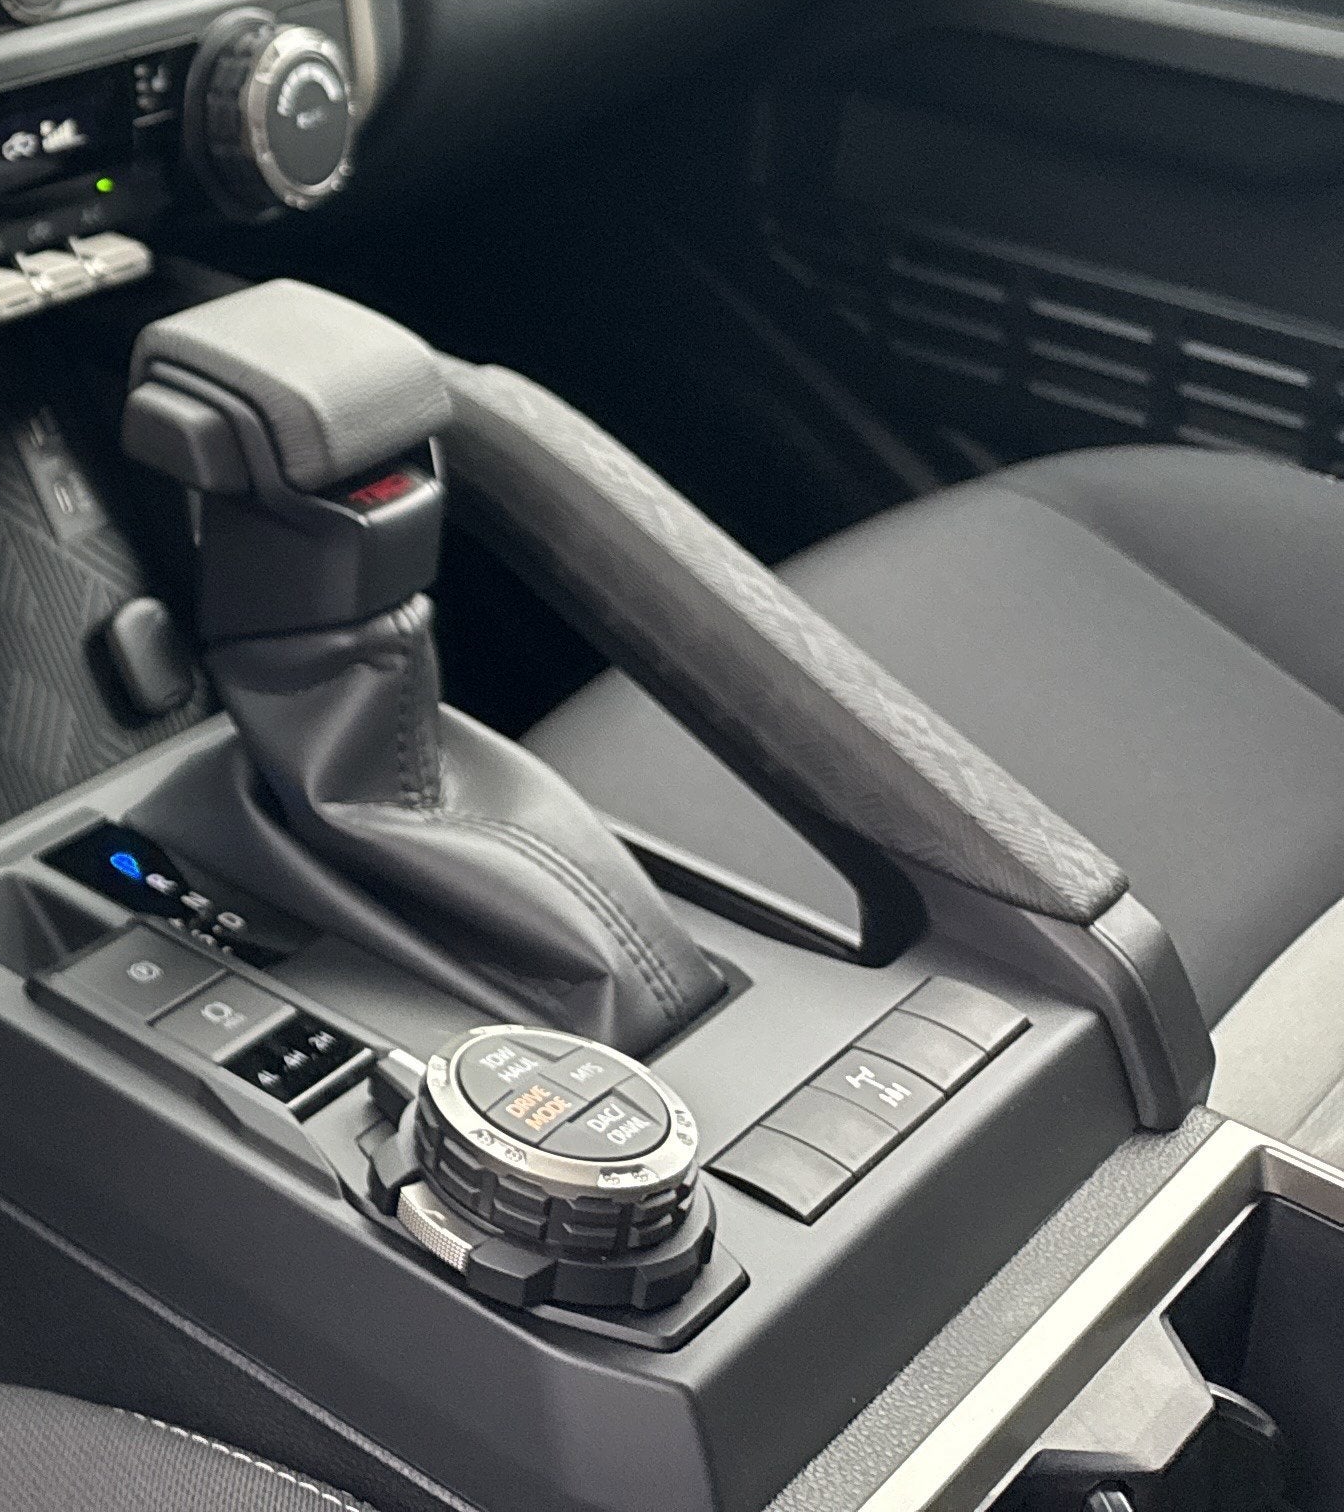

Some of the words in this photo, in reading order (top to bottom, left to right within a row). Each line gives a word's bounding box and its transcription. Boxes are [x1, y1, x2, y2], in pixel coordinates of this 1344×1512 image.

[569, 1062, 605, 1082] MTS
[505, 1085, 552, 1118] DRIVE
[525, 1096, 572, 1131] MODE
